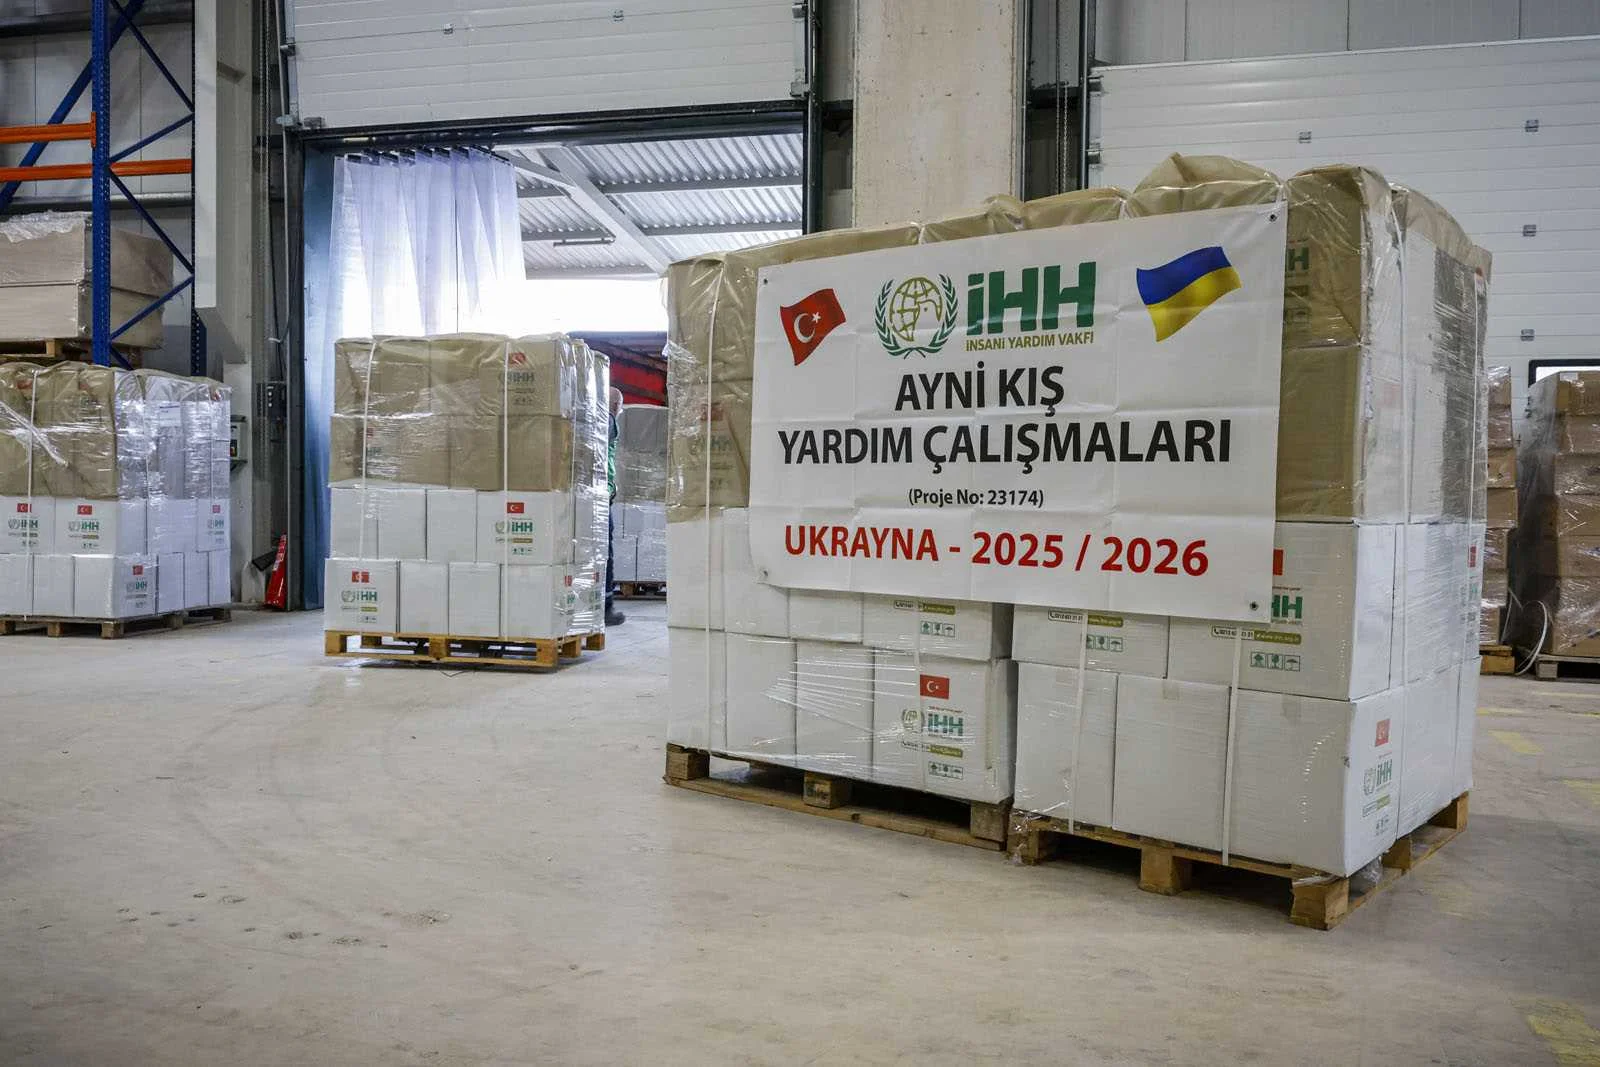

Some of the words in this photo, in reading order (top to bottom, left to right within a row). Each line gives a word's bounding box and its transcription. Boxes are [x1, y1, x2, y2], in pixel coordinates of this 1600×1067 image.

[1008, 334, 1055, 349] YARDIM
[894, 360, 985, 411] AYNİ
[999, 365, 1065, 417] KIŞ
[778, 427, 912, 465] YARDIM
[923, 419, 1231, 475] ÇALIŞMALARI
[908, 488, 953, 508] (Proje
[956, 489, 984, 505] No:
[987, 490, 1044, 508] 23174)
[785, 525, 939, 562] UKRAYNA
[971, 531, 1063, 569] 2025
[1074, 534, 1092, 571] /
[1101, 536, 1209, 577] 2026
